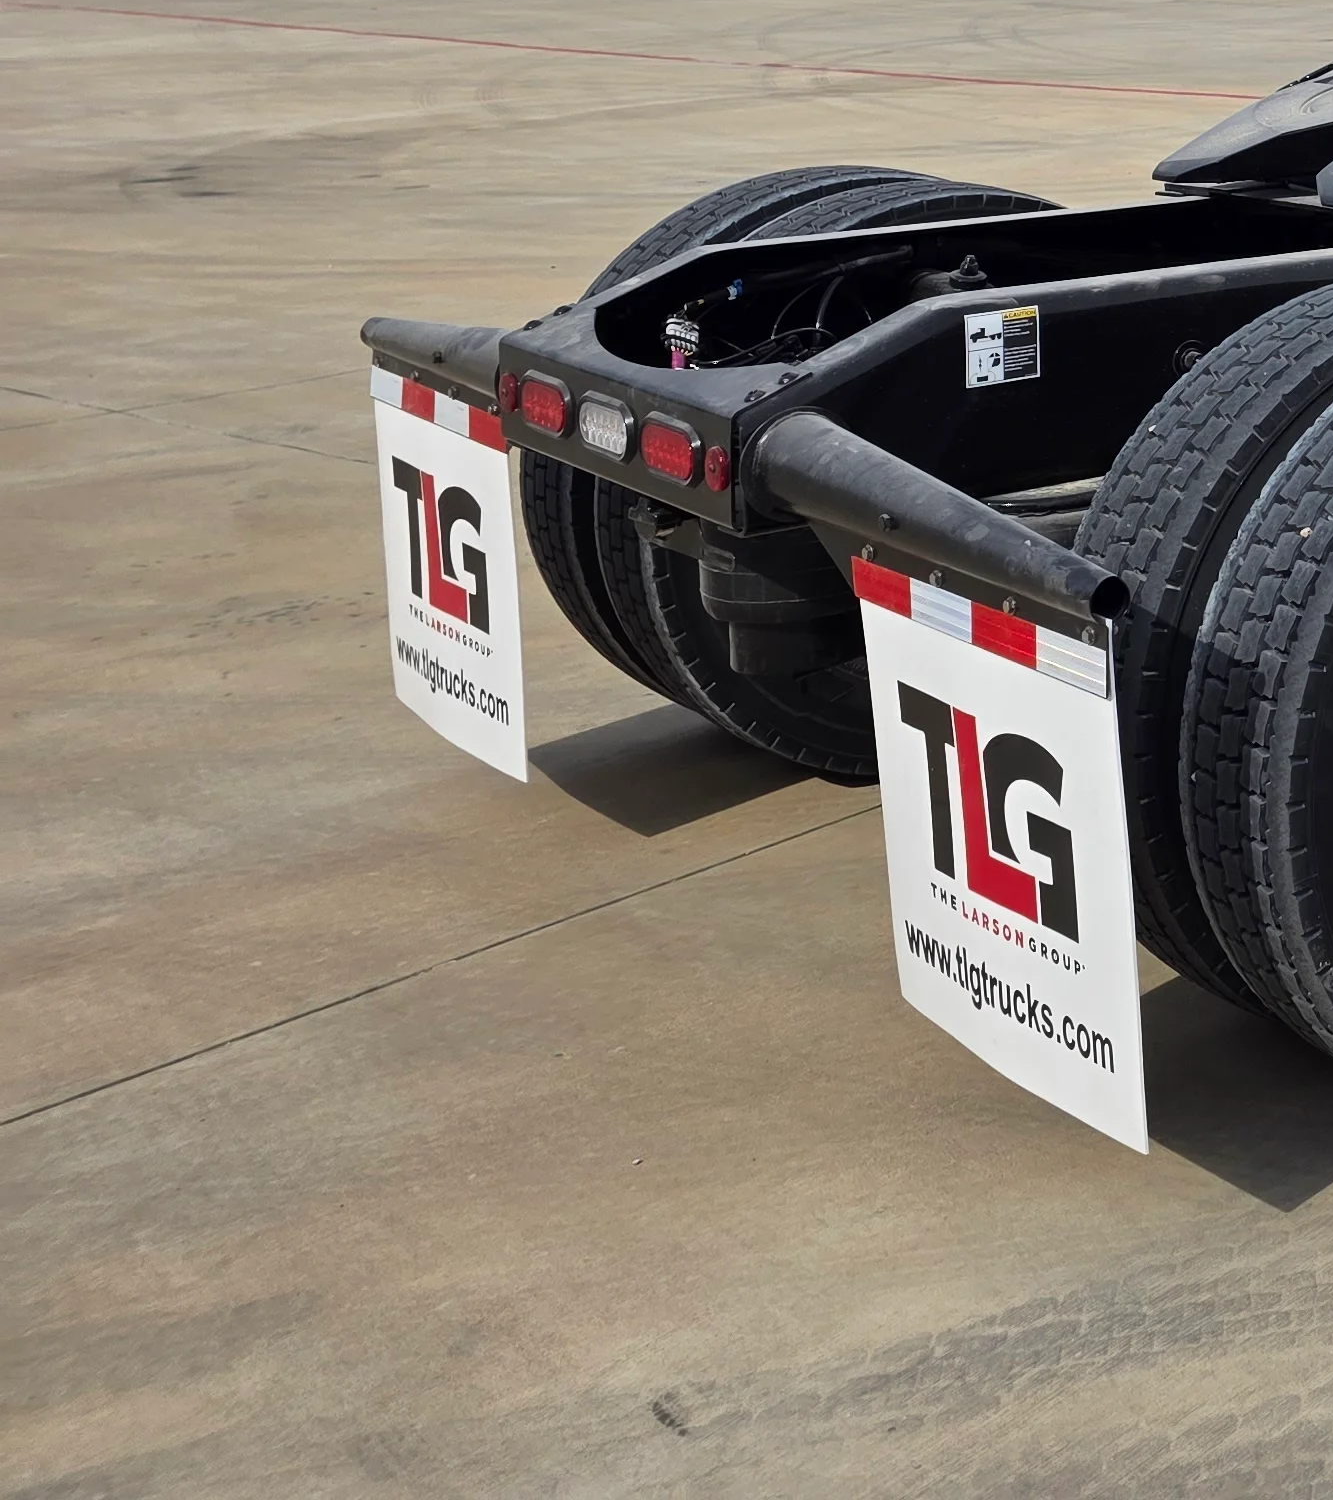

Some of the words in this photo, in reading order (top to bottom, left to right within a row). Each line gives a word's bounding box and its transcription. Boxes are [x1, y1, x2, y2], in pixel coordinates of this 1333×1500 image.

[1008, 309, 1036, 319] CAUTION
[391, 455, 490, 636] TLG
[408, 603, 424, 623] THE
[424, 613, 461, 643] LARSON
[462, 634, 491, 658] GROUP
[396, 635, 510, 727] www.tlgtrucks.com
[896, 679, 1080, 944] TLG
[930, 882, 958, 911] THE
[961, 901, 1025, 949] LARSON
[1028, 937, 1081, 975] GROUP
[904, 919, 1115, 1074] www.tlgtrucks.com
